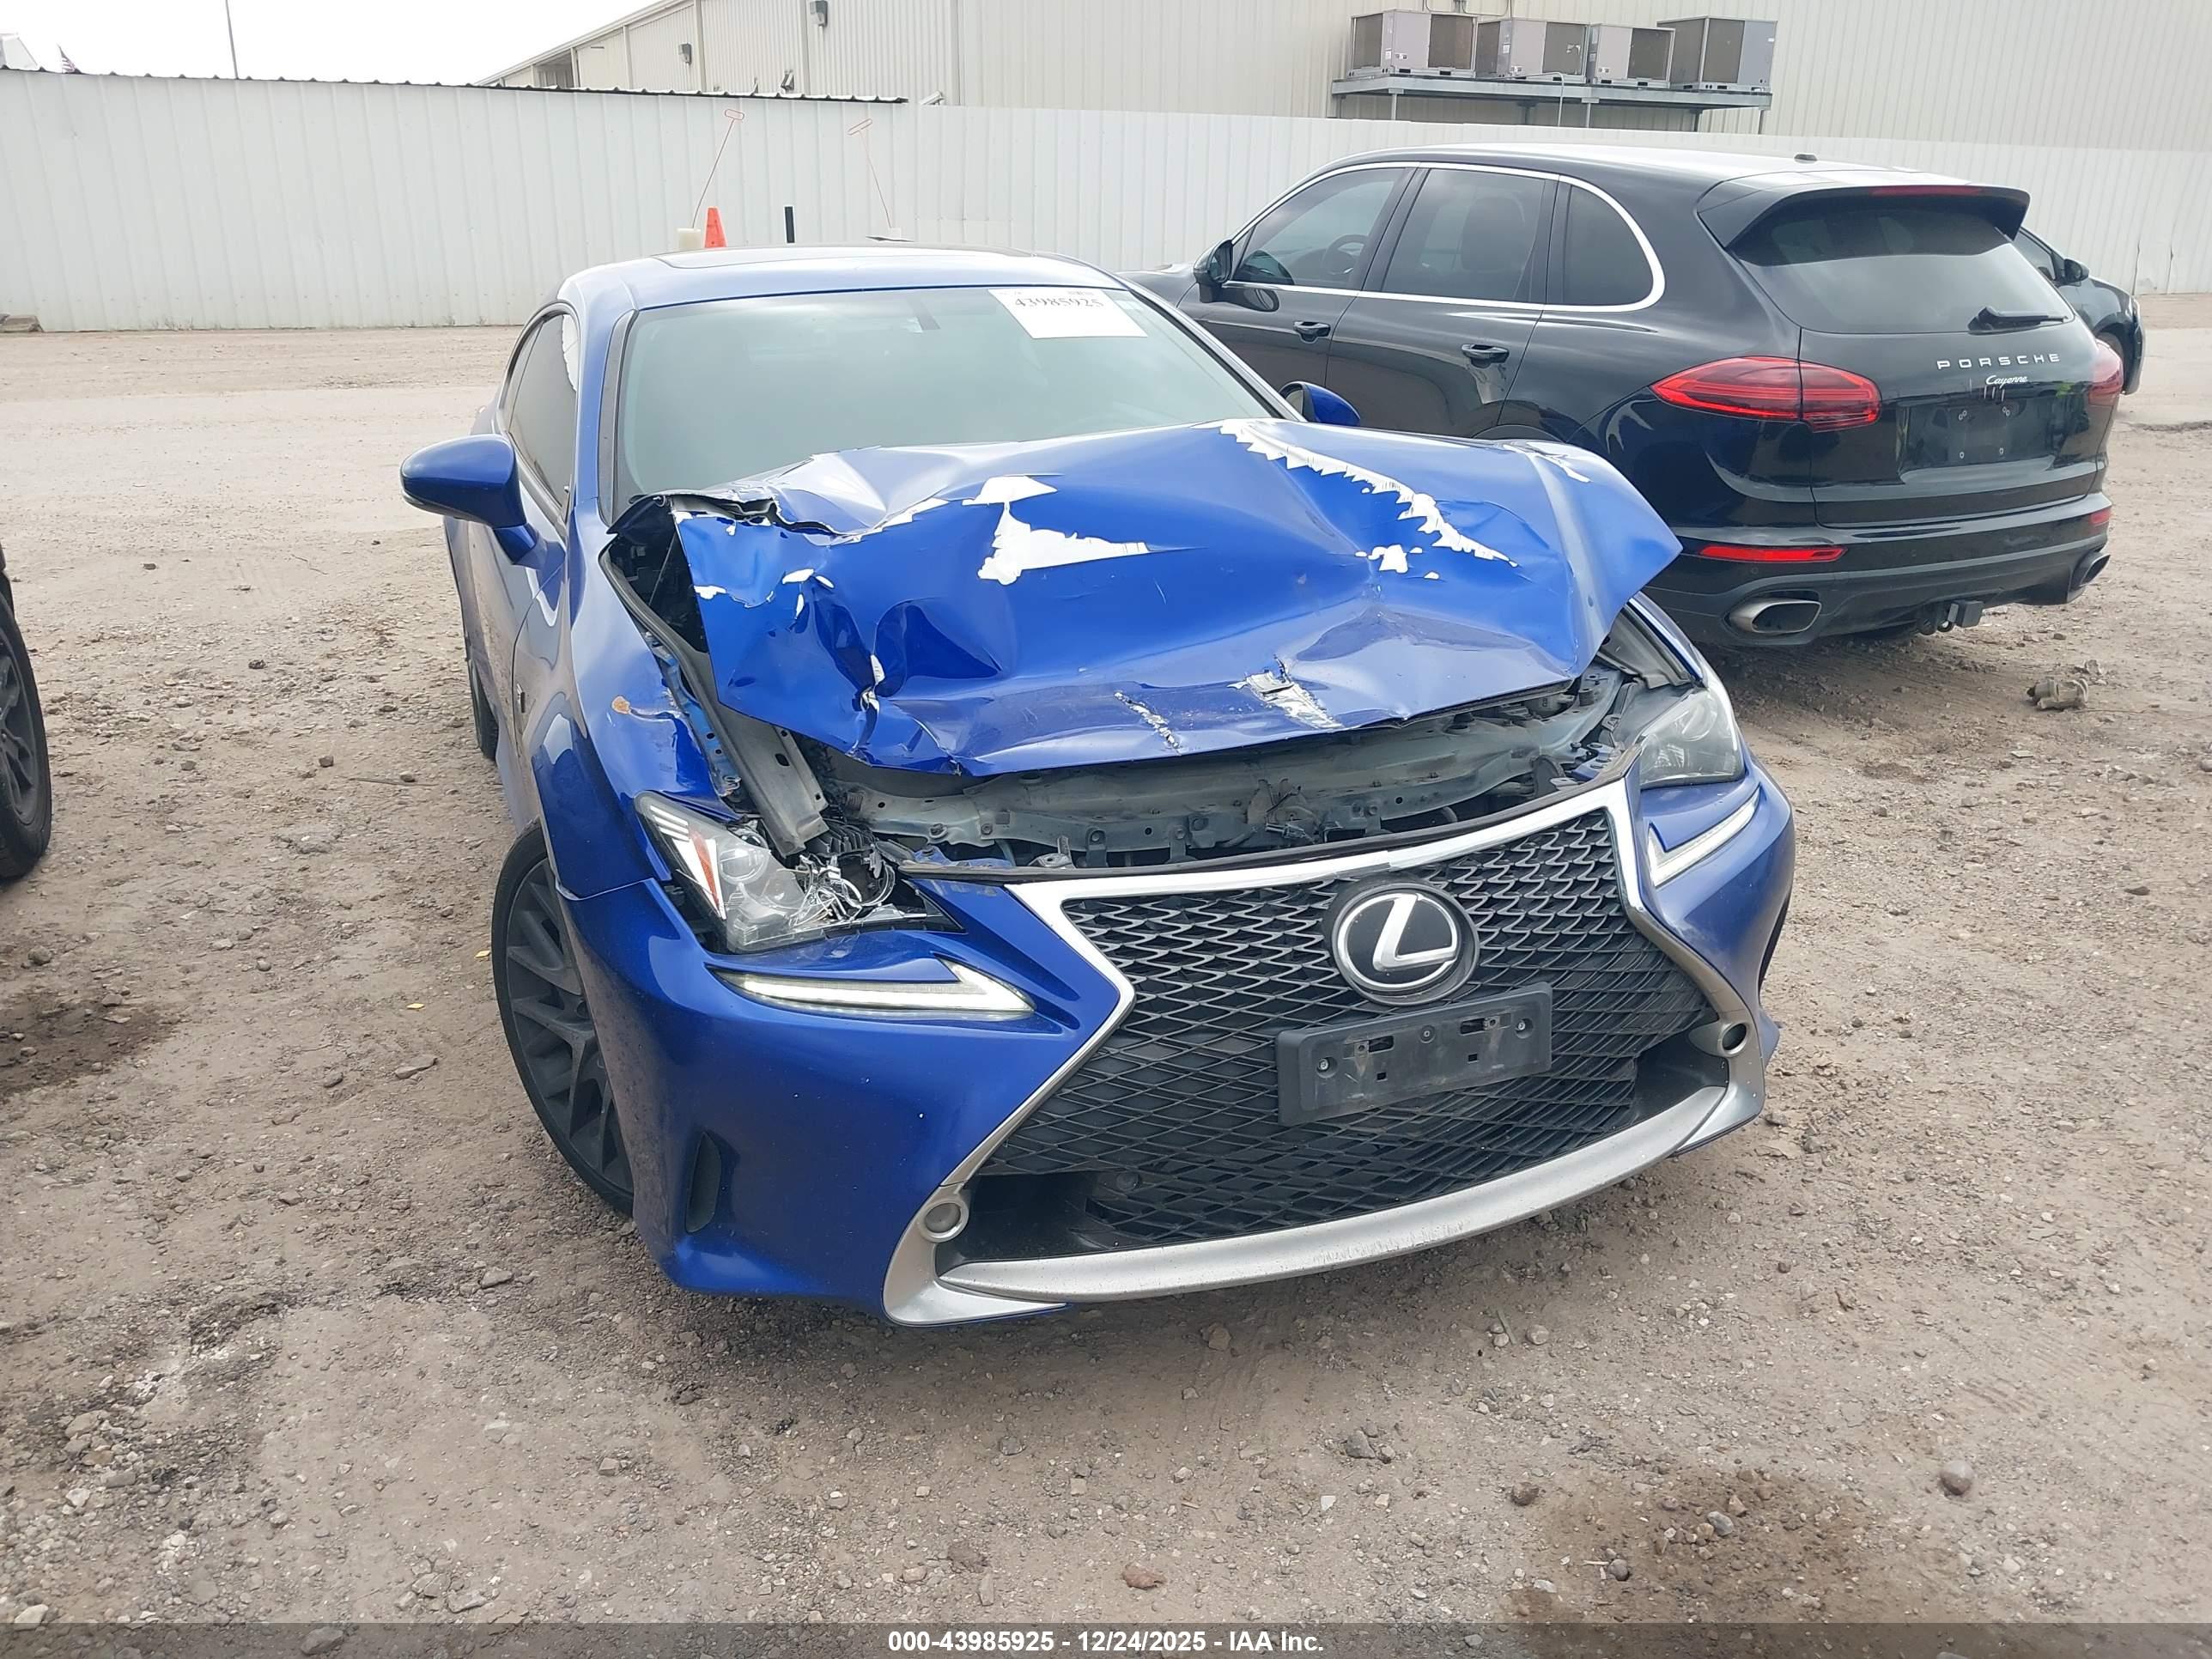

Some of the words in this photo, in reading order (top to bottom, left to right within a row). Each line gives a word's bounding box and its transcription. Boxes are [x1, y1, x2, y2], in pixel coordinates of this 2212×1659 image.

[1015, 298, 1104, 307] 43985925
[1936, 353, 2060, 369] PORSCHE
[1985, 374, 2028, 389] Cayenne
